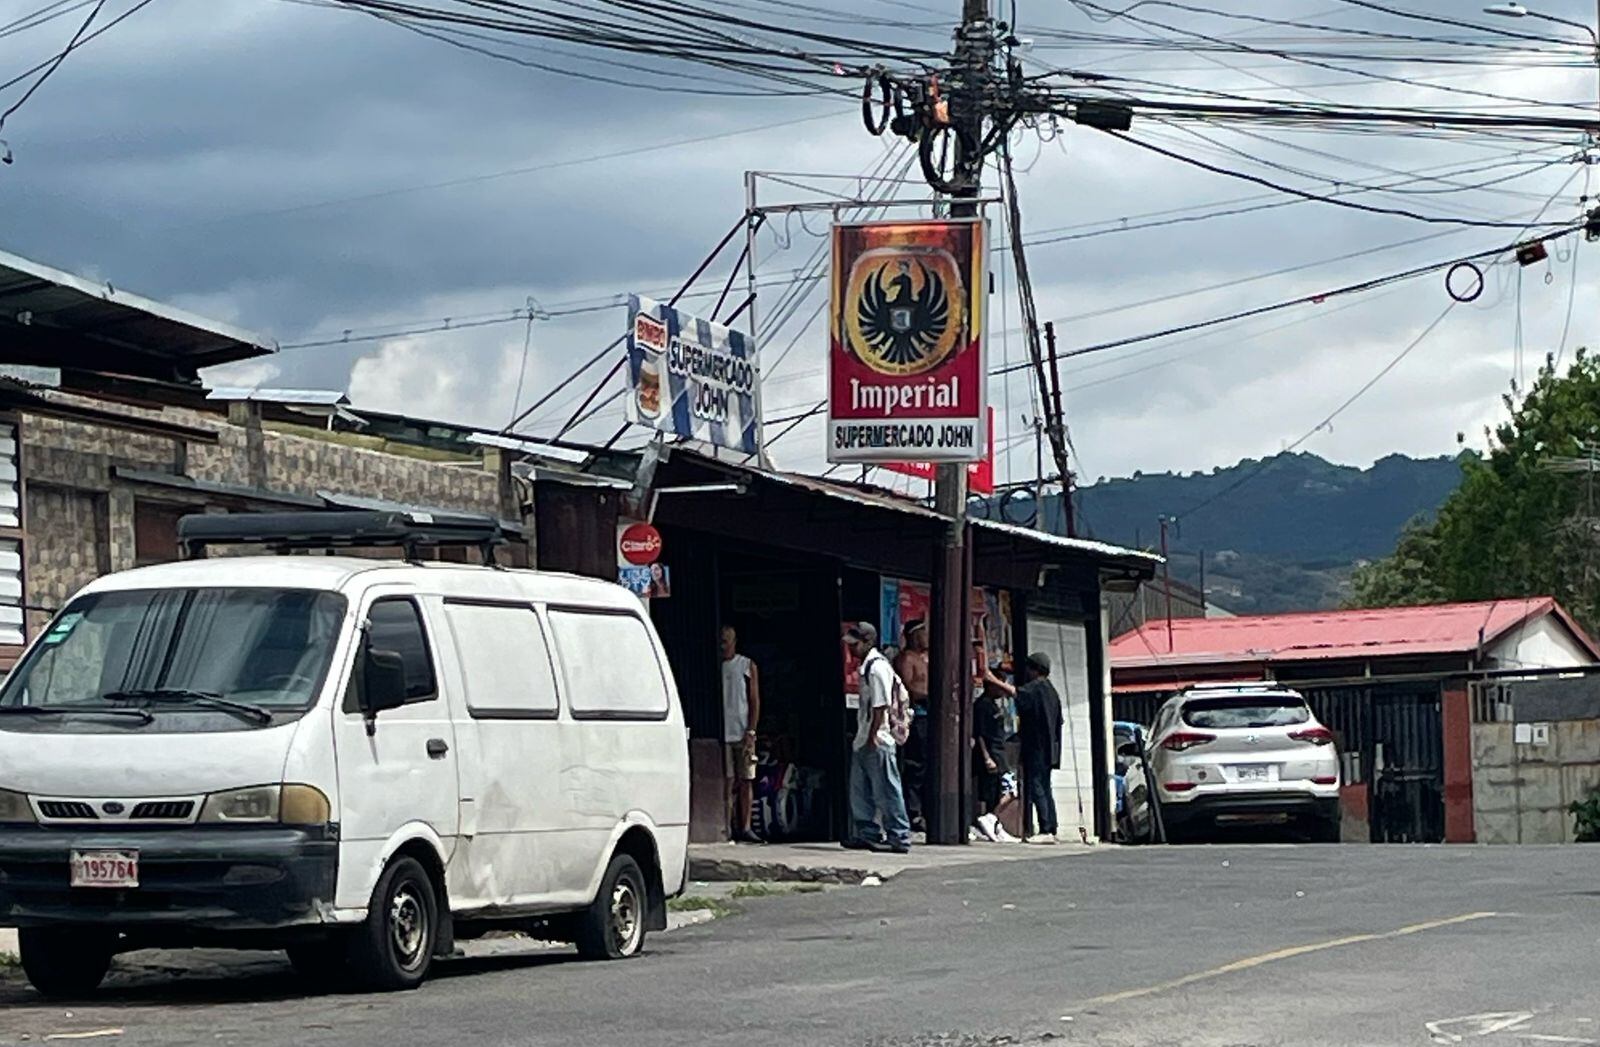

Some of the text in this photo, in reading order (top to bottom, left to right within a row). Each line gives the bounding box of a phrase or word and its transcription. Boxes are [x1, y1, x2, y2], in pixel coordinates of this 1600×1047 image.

[670, 339, 753, 391] SUPERMERCADO
[695, 382, 729, 418] JOHN
[850, 376, 958, 416] Imperial
[835, 424, 973, 449] SUPERMERCADO JOHN
[83, 860, 135, 880] 195764
